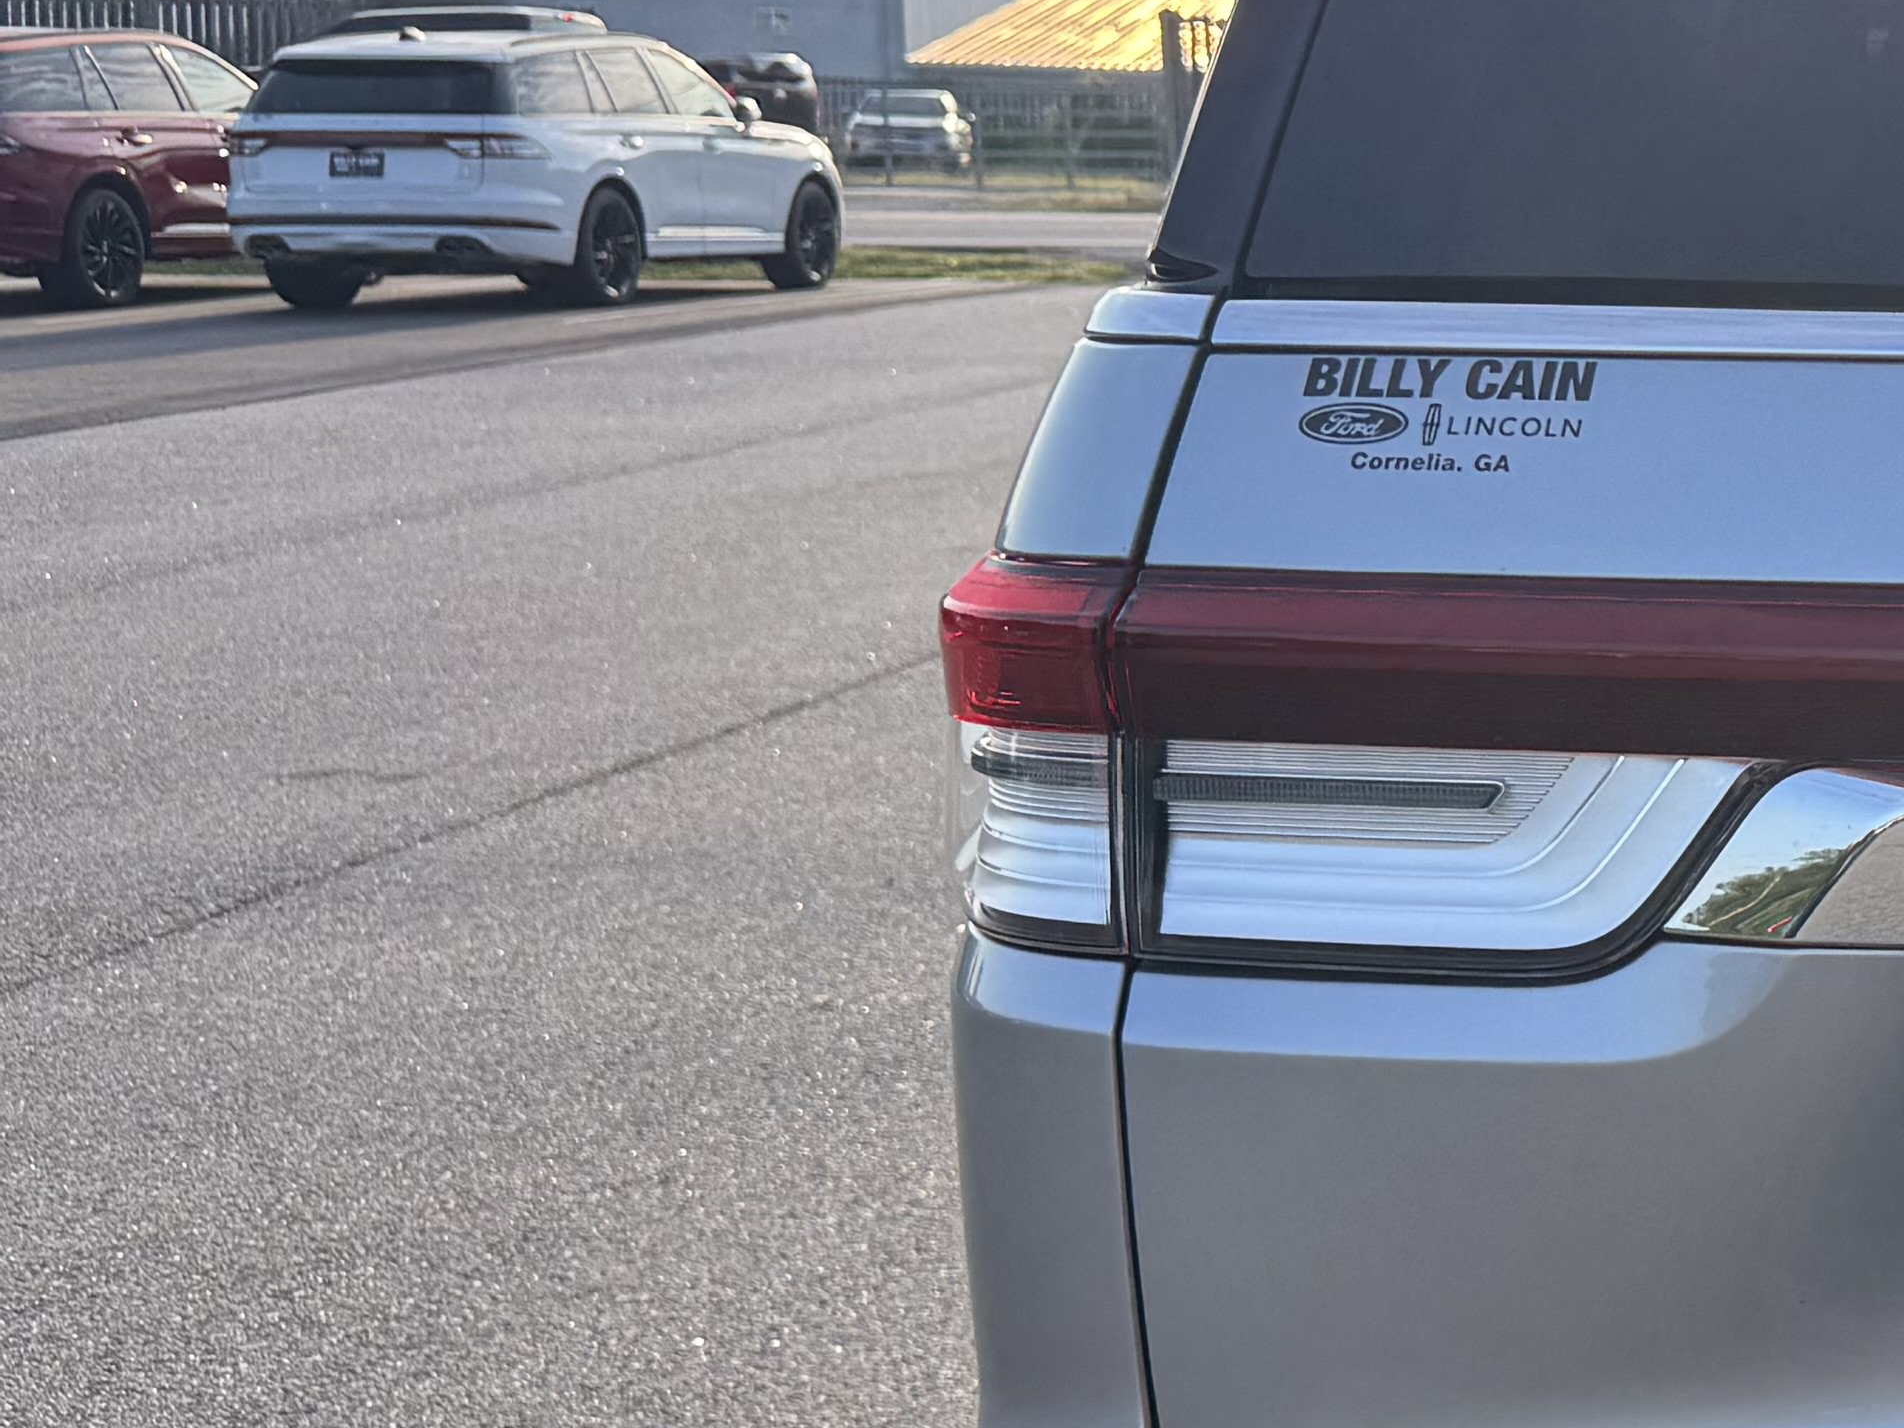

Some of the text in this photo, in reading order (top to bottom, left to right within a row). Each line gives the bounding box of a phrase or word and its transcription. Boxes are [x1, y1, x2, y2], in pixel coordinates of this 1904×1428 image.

[1302, 356, 1598, 401] BILLY CAIN
[1319, 411, 1385, 438] Ford
[1446, 416, 1583, 438] LINCOLN
[1474, 453, 1511, 473] GA
